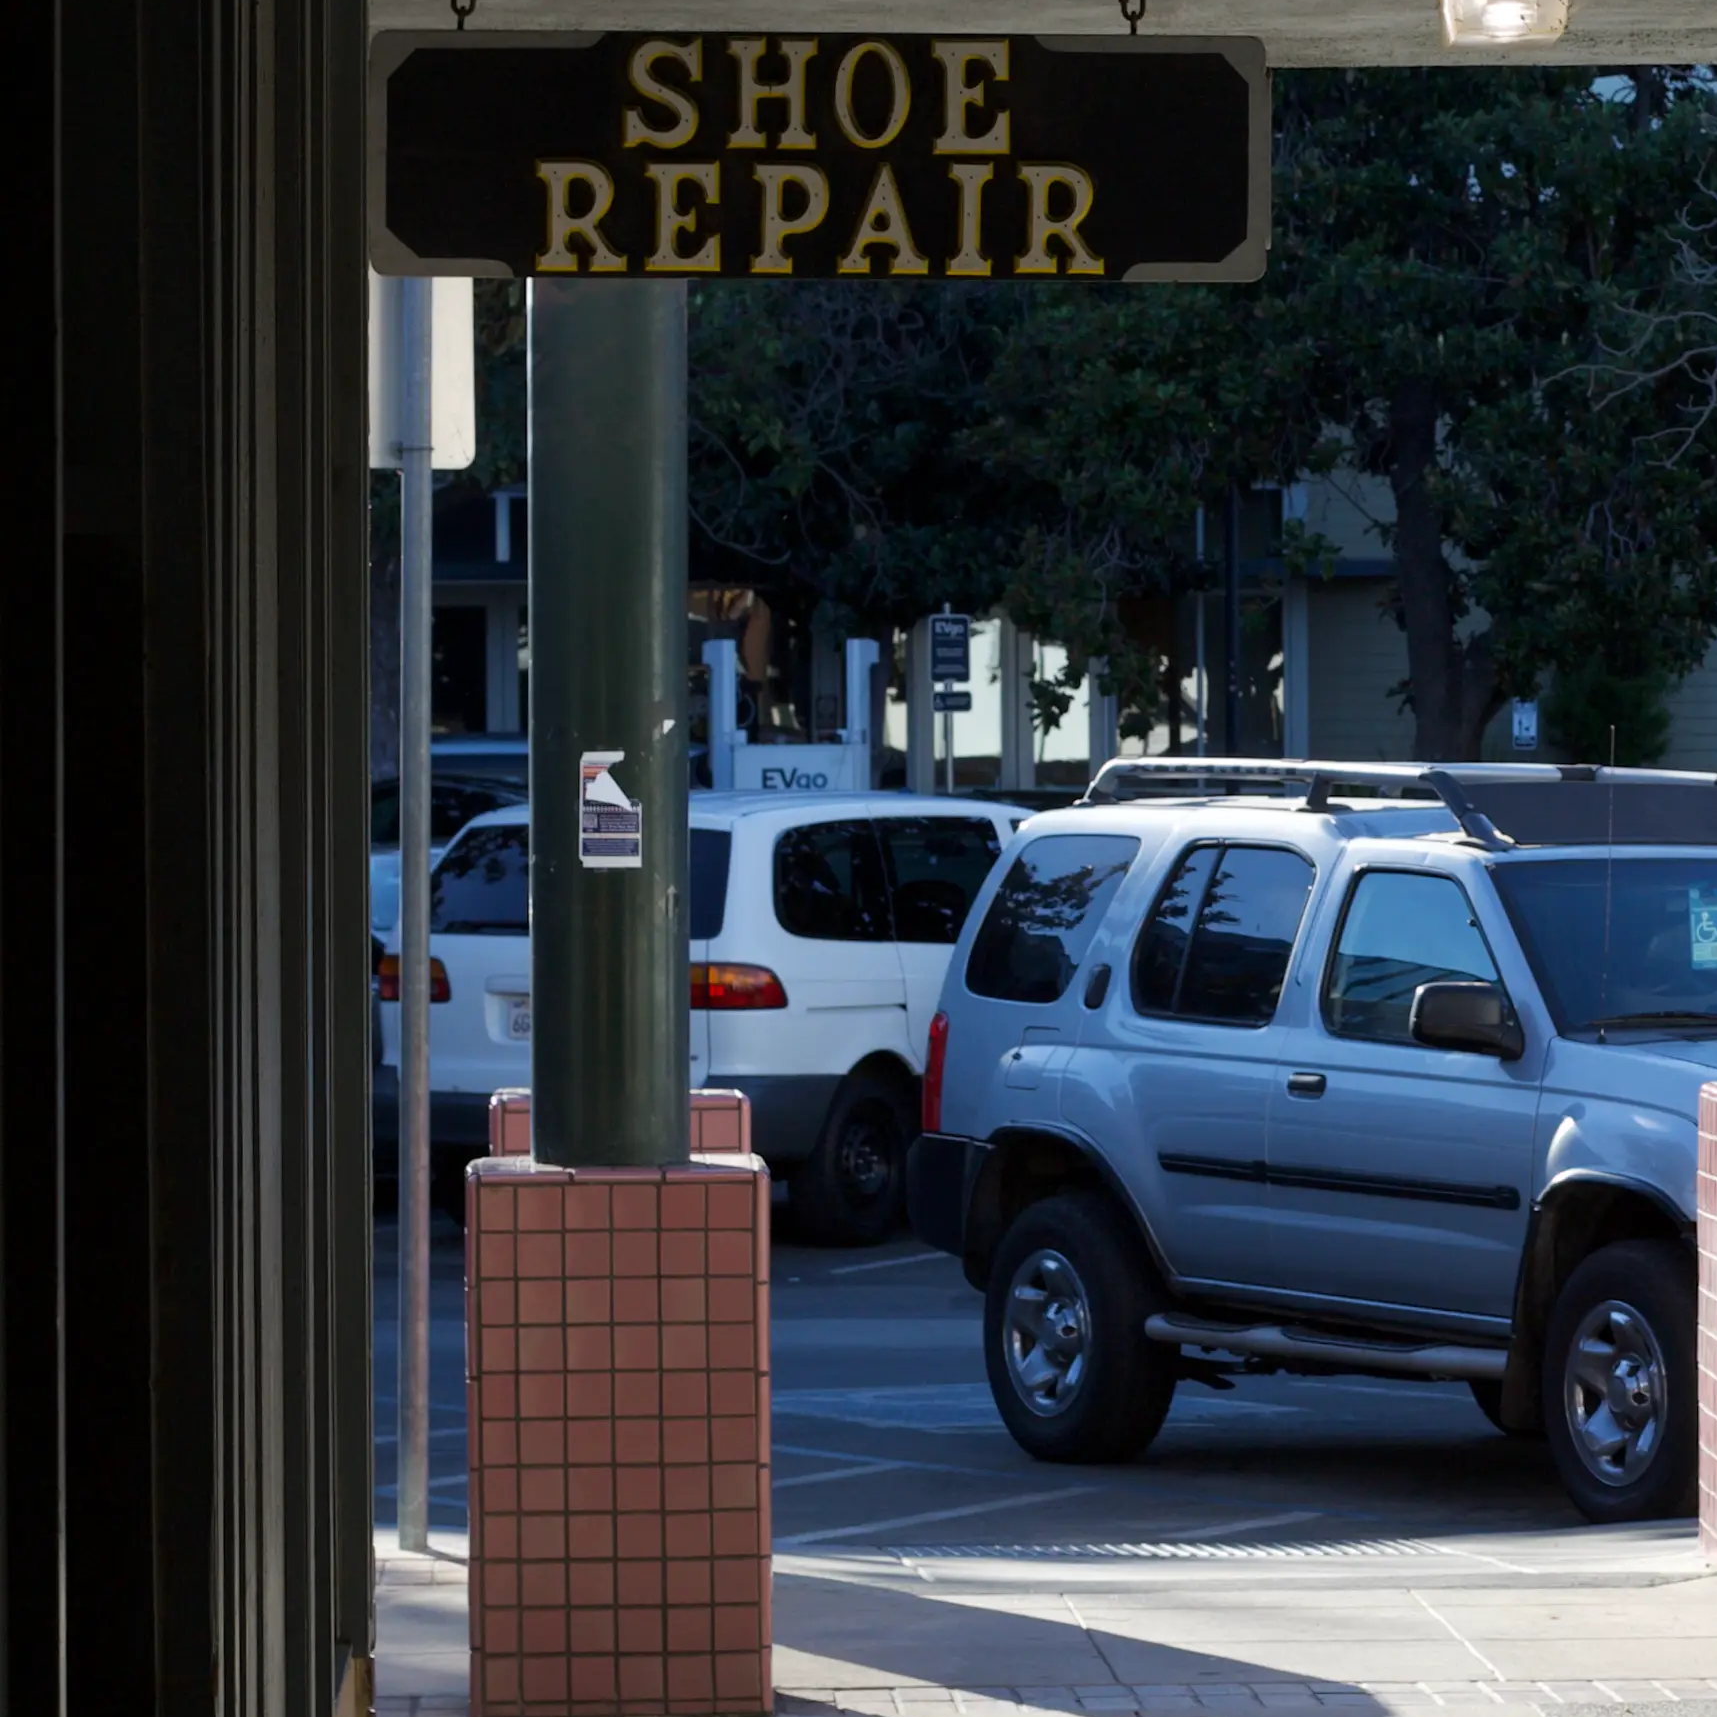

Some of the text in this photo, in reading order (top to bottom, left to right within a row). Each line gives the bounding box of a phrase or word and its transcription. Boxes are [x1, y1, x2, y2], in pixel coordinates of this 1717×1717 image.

[621, 37, 1012, 156] SHOE
[534, 158, 1106, 277] REPAIR
[762, 767, 828, 789] EVgo
